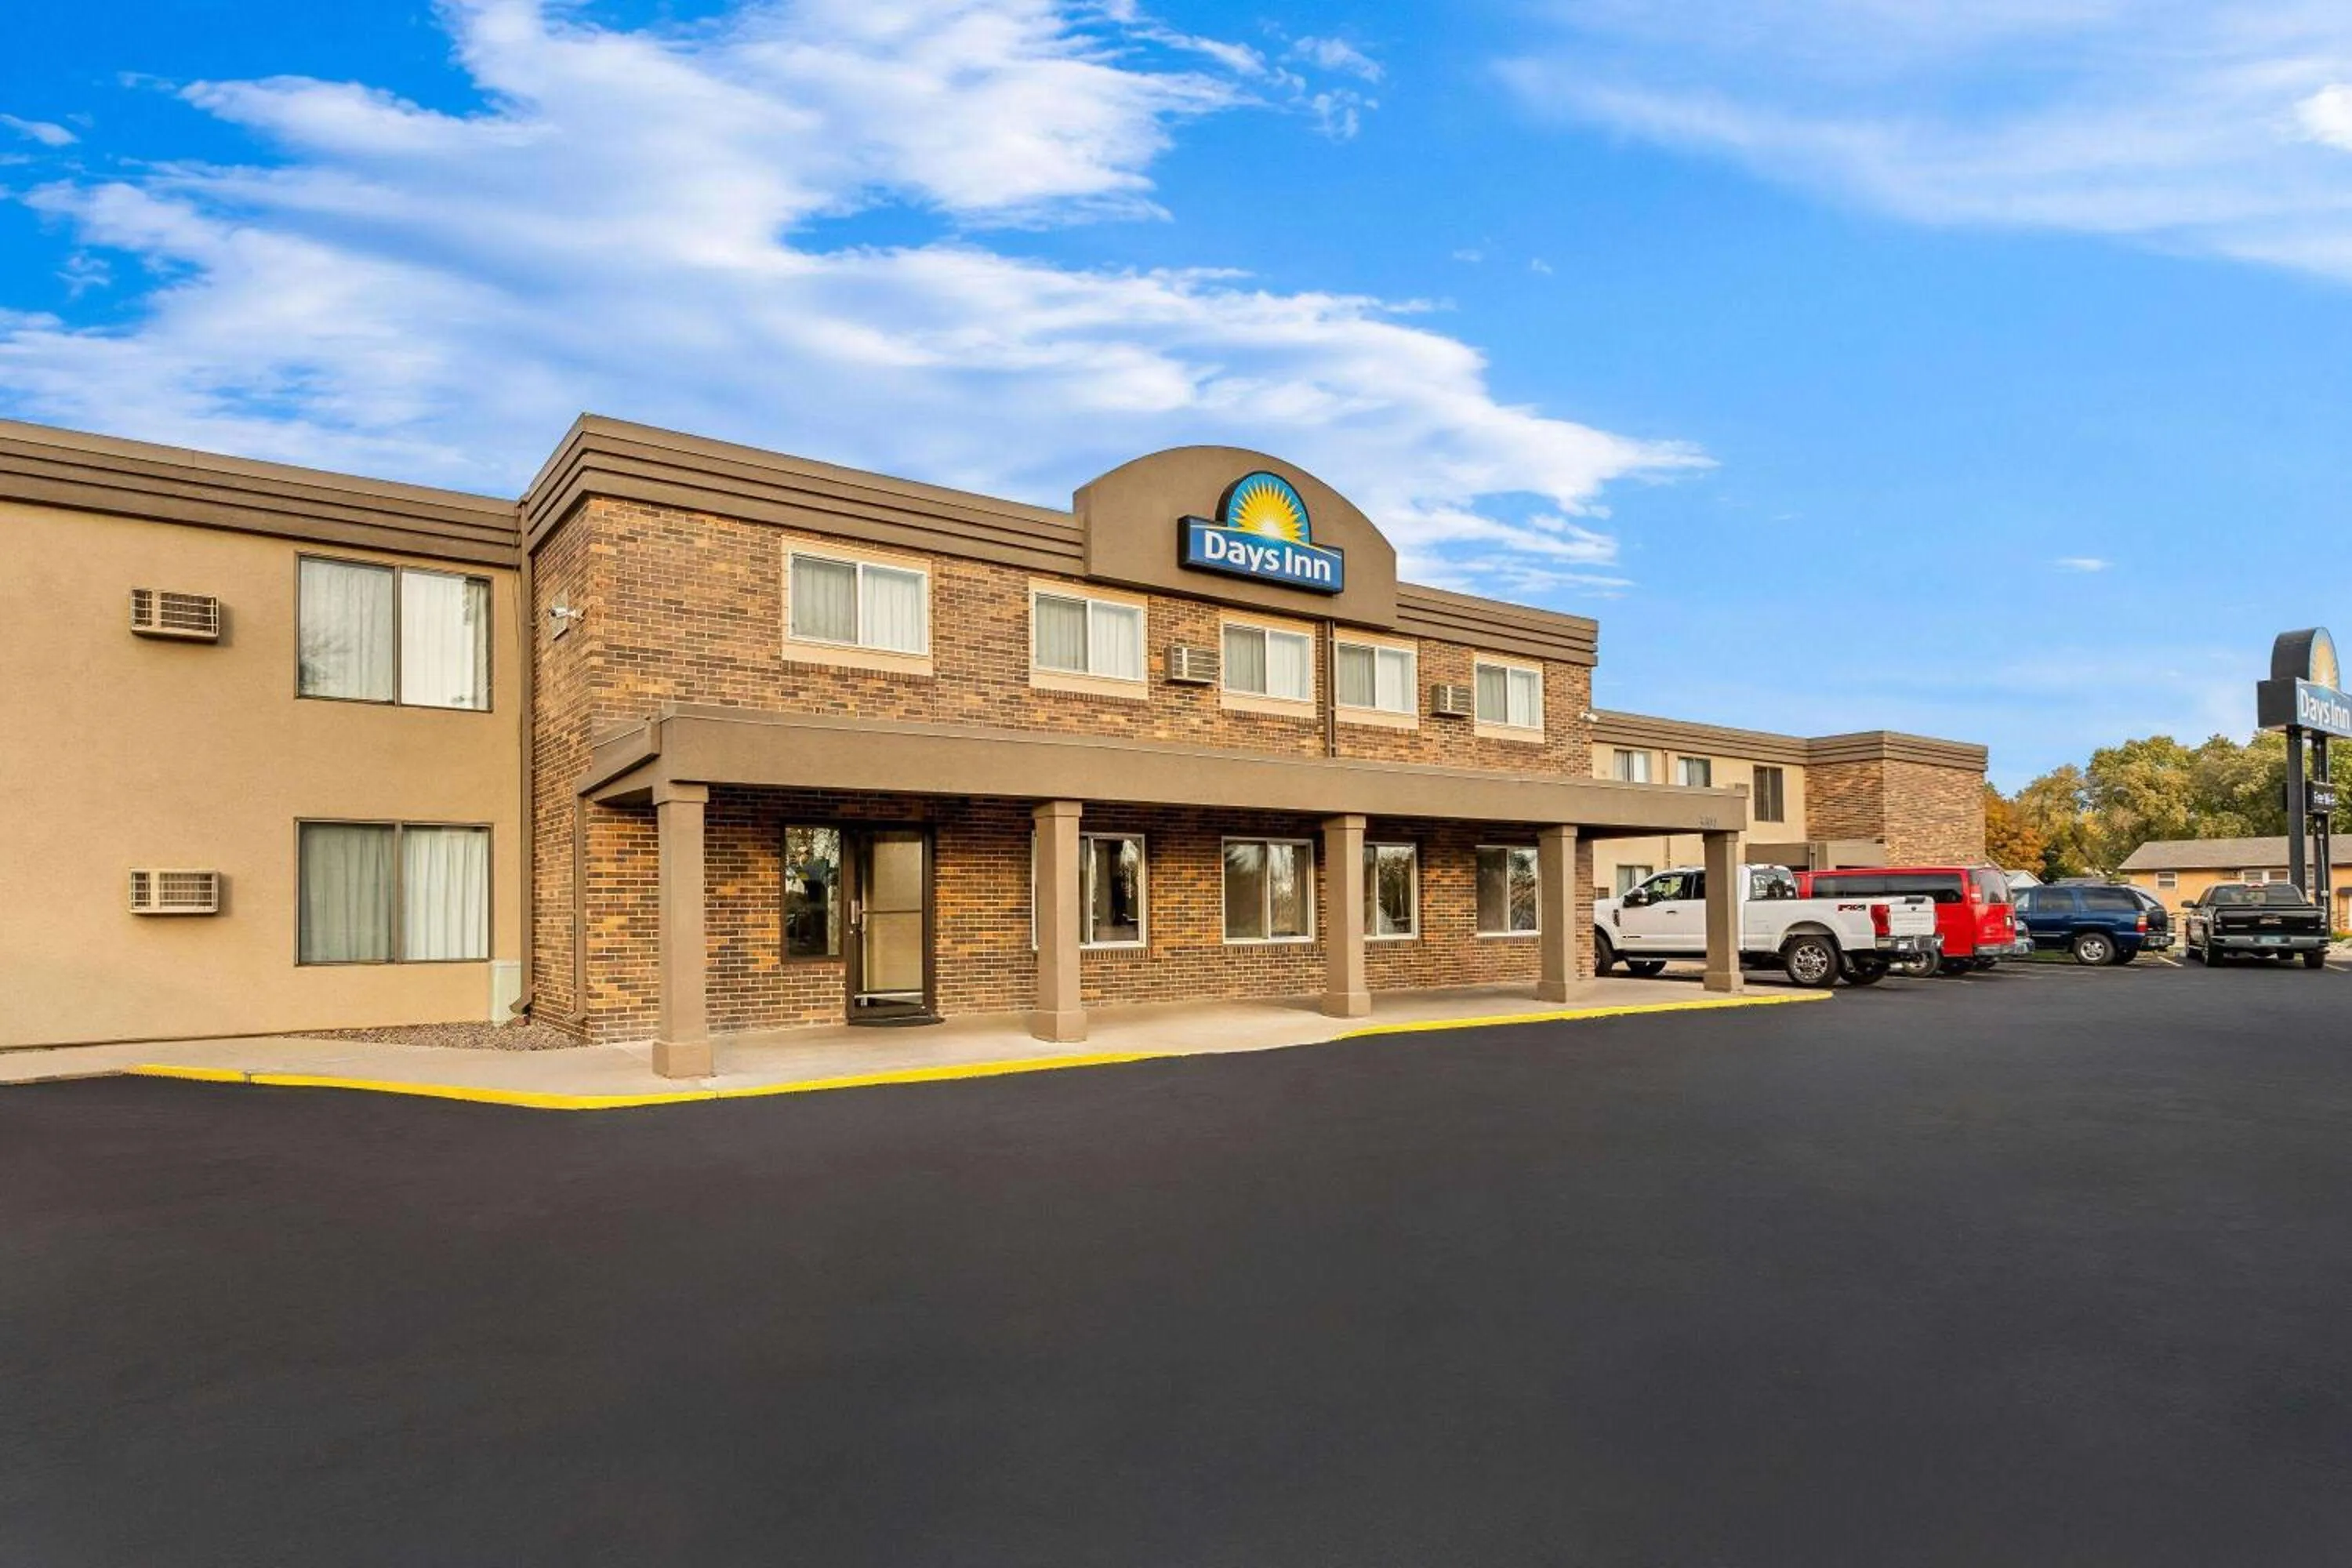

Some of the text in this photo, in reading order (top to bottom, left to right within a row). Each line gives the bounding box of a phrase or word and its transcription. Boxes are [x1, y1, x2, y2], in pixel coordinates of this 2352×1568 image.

[1204, 529, 1330, 582] Days Inn
[2299, 688, 2350, 728] Days Inn
